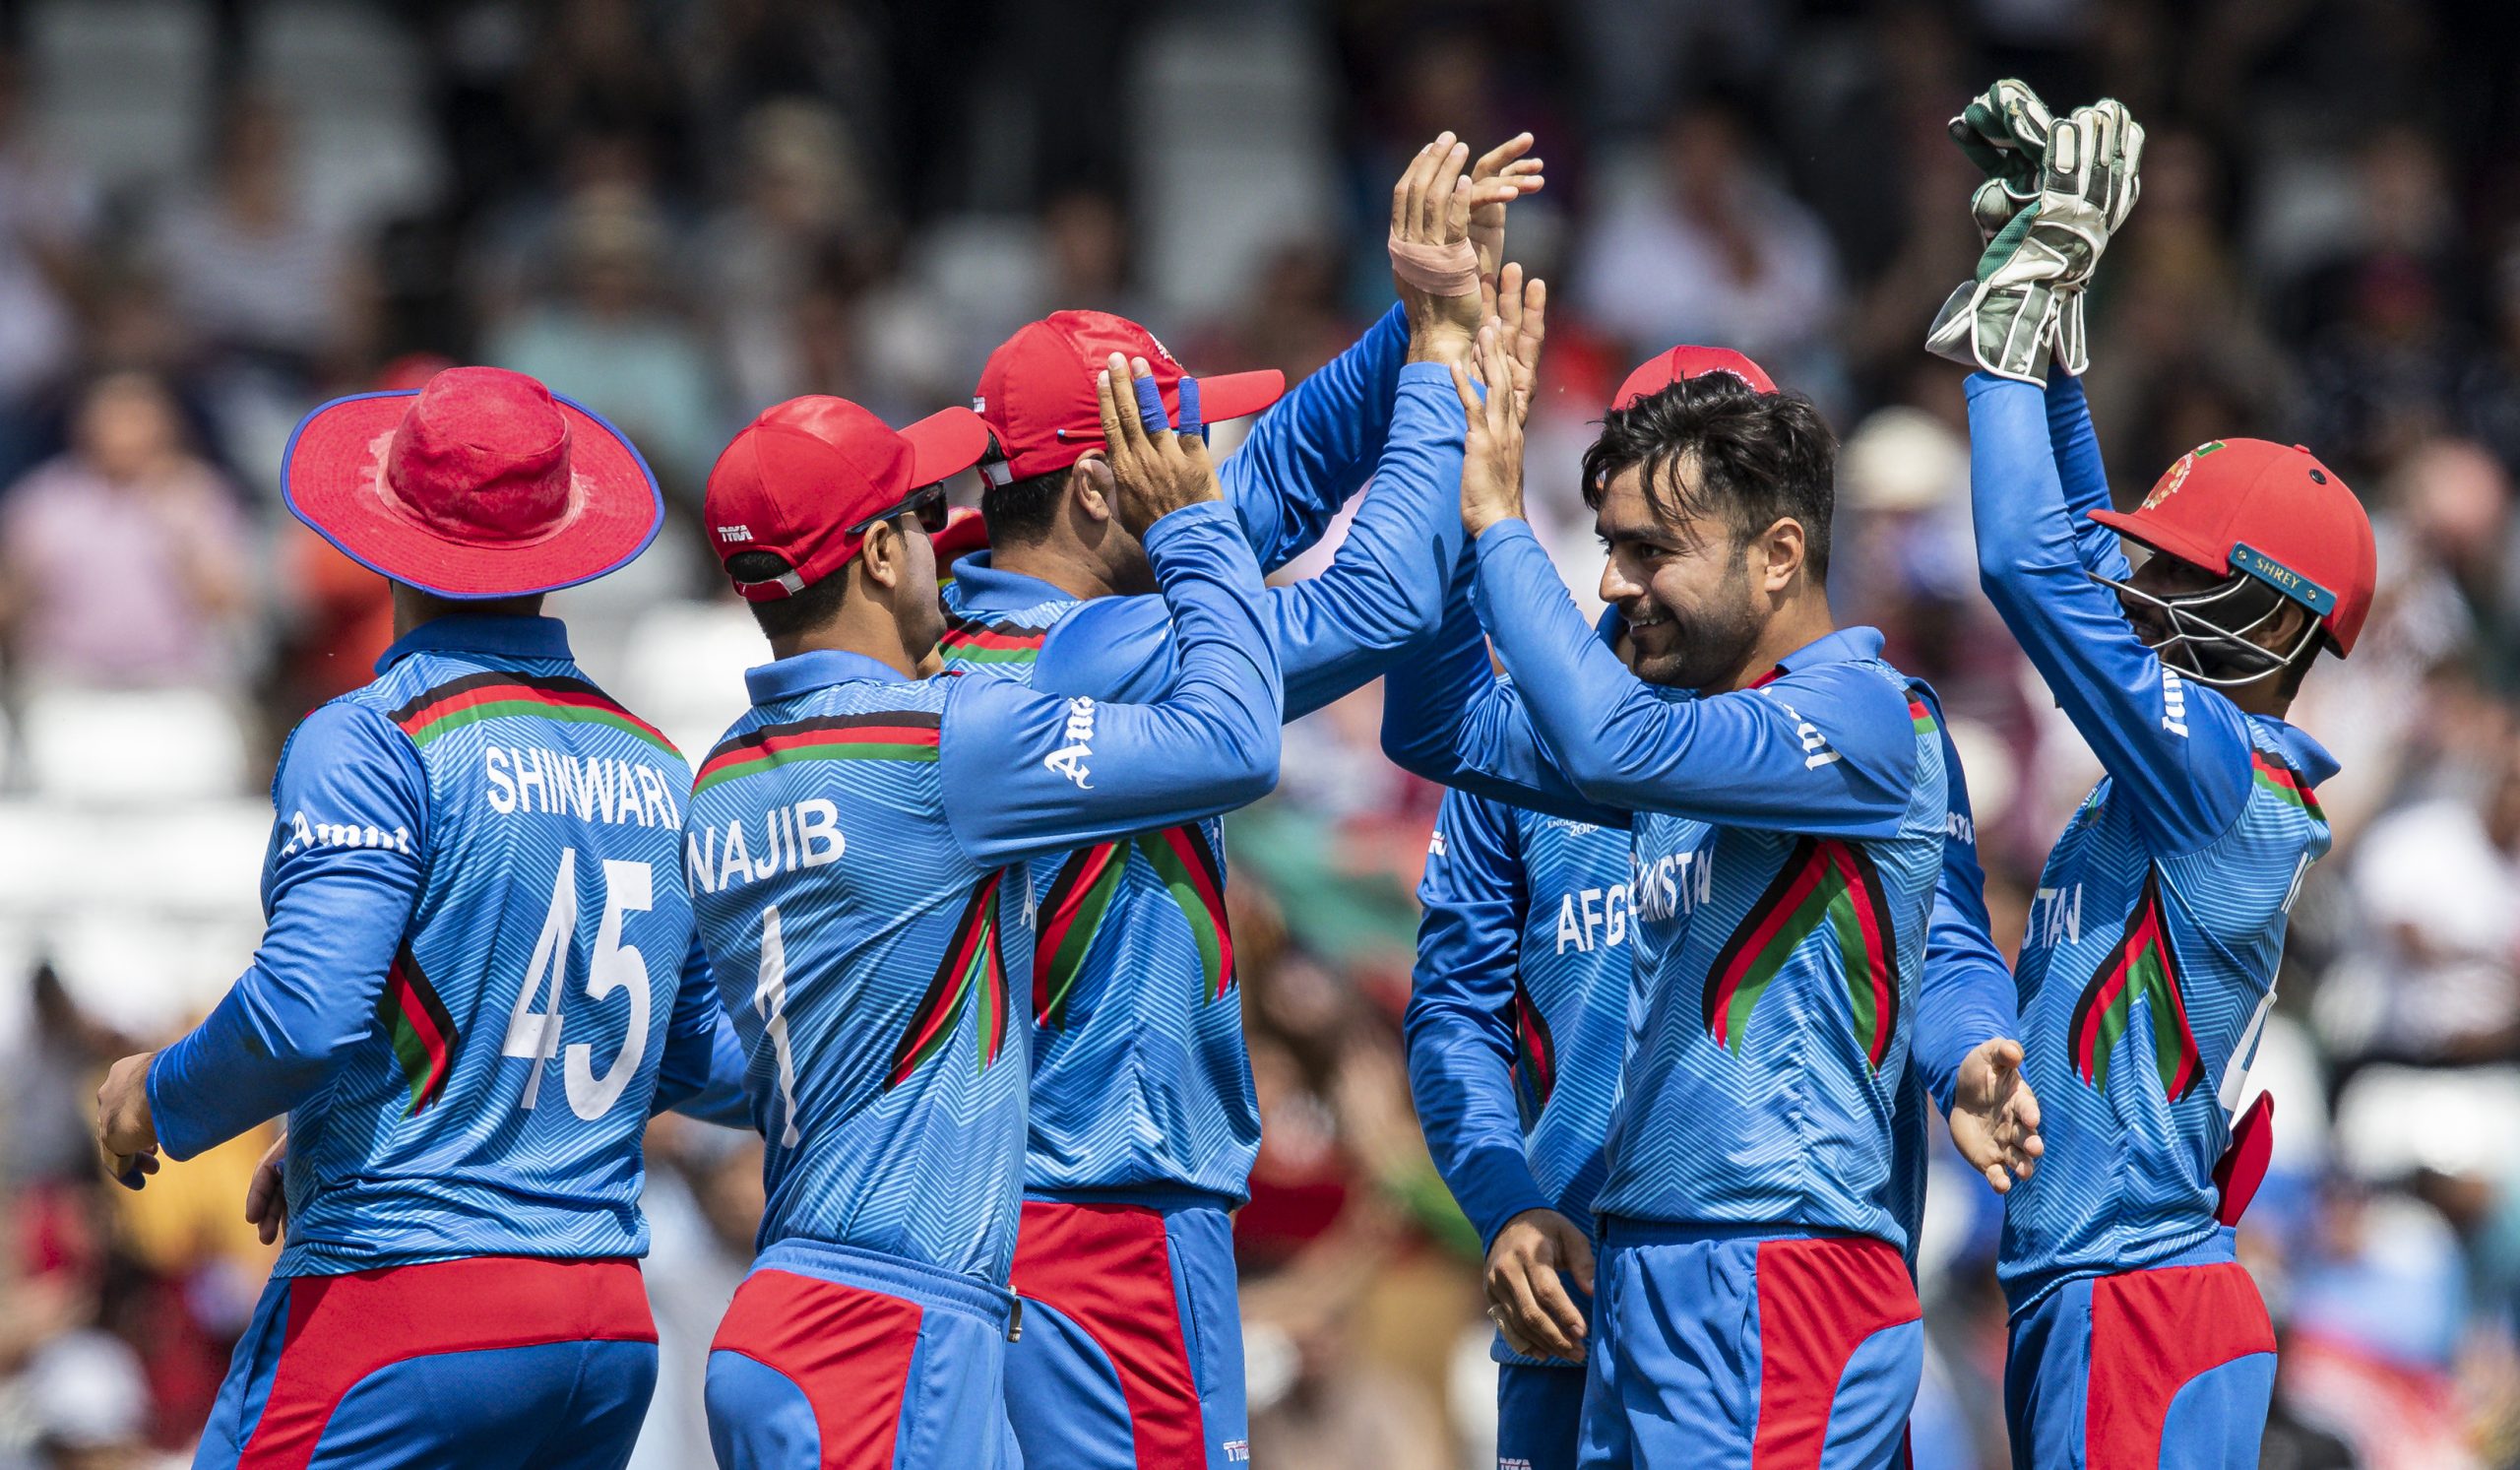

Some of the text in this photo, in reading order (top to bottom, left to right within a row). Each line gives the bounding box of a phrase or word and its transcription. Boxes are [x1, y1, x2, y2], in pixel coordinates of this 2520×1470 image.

[2255, 557, 2300, 589] SHREY
[485, 745, 681, 830] SHINWARI
[687, 798, 847, 899] NAJIB
[501, 846, 653, 1121] 45
